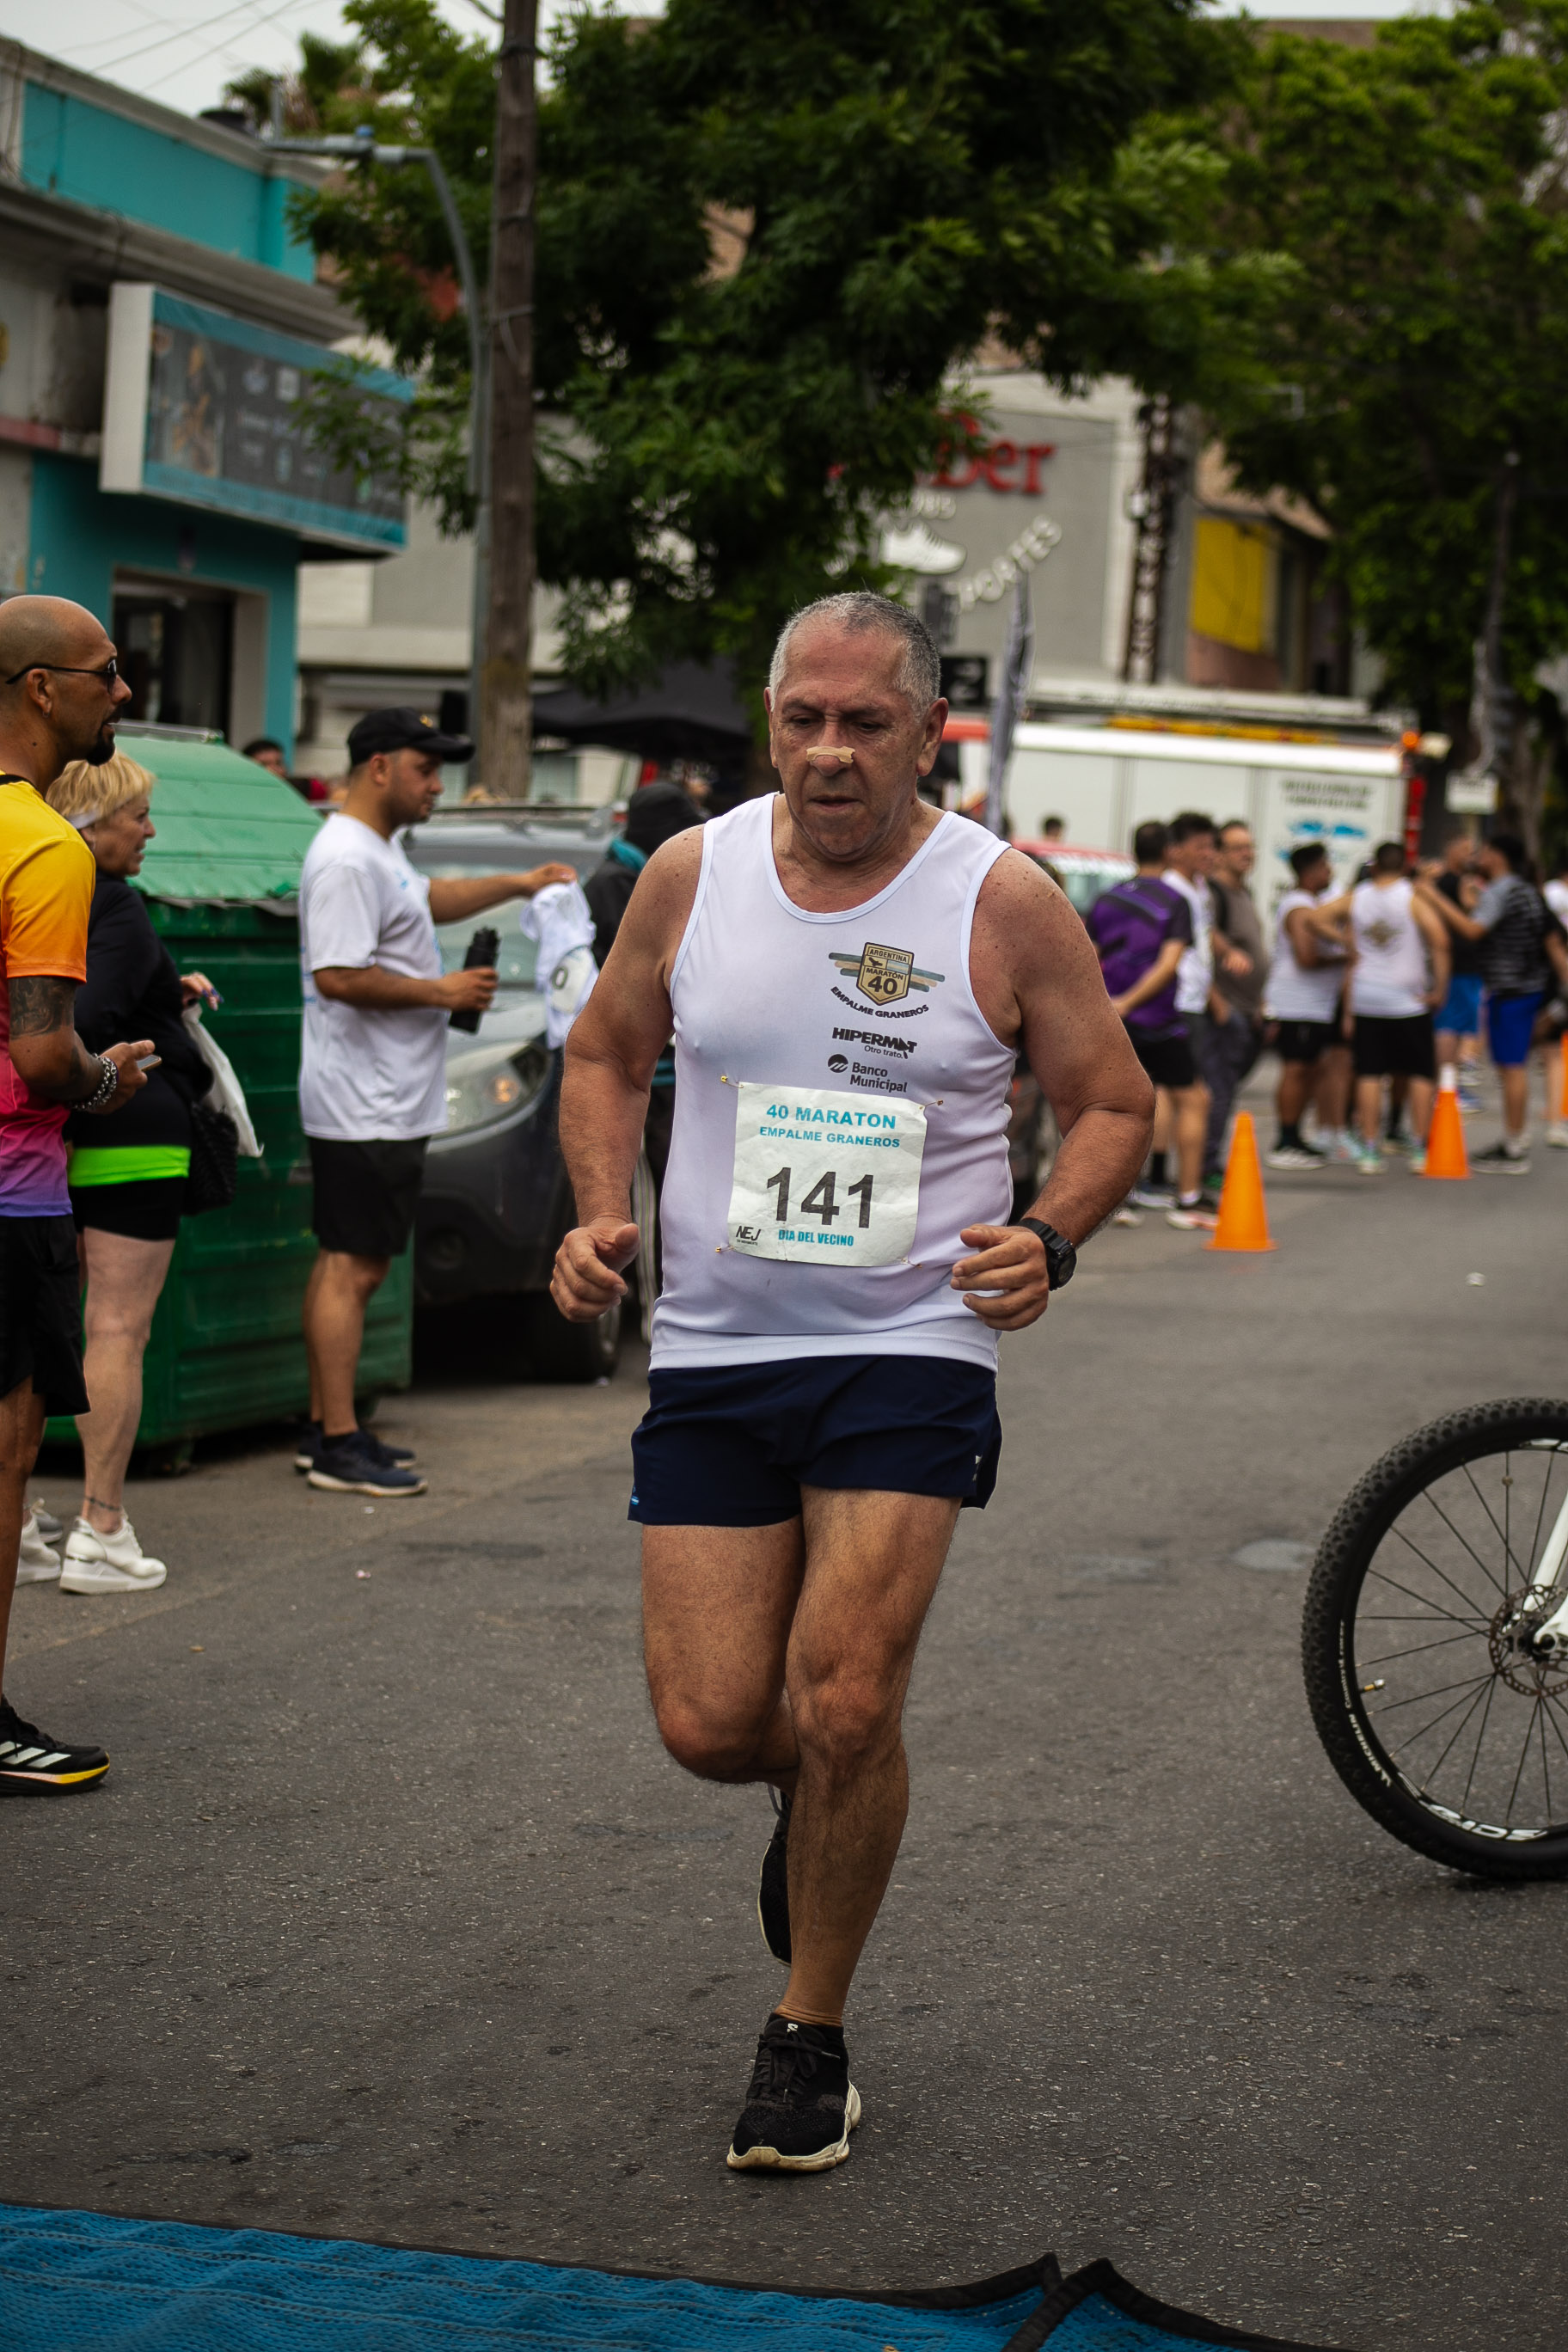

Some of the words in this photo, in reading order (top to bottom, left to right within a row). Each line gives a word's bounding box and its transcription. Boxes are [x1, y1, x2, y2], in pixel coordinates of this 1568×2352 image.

[869, 948, 908, 962] ARGENTINA
[867, 976, 897, 995] 40
[830, 986, 873, 1015] EMPALME
[875, 1004, 929, 1018] GRANEROS
[864, 1045, 881, 1055] Otro
[852, 1062, 888, 1077] Banco
[850, 1074, 908, 1093] Municipal
[766, 1104, 788, 1119] 40
[795, 1106, 897, 1130] MARATON
[759, 1126, 822, 1142] EMPALME
[826, 1132, 900, 1148] GRANEROS
[767, 1167, 874, 1228] 141
[778, 1229, 795, 1241] DIA
[798, 1231, 815, 1244] DEL
[818, 1233, 854, 1246] VECINO
[1349, 1713, 1381, 1773] MICHELIN
